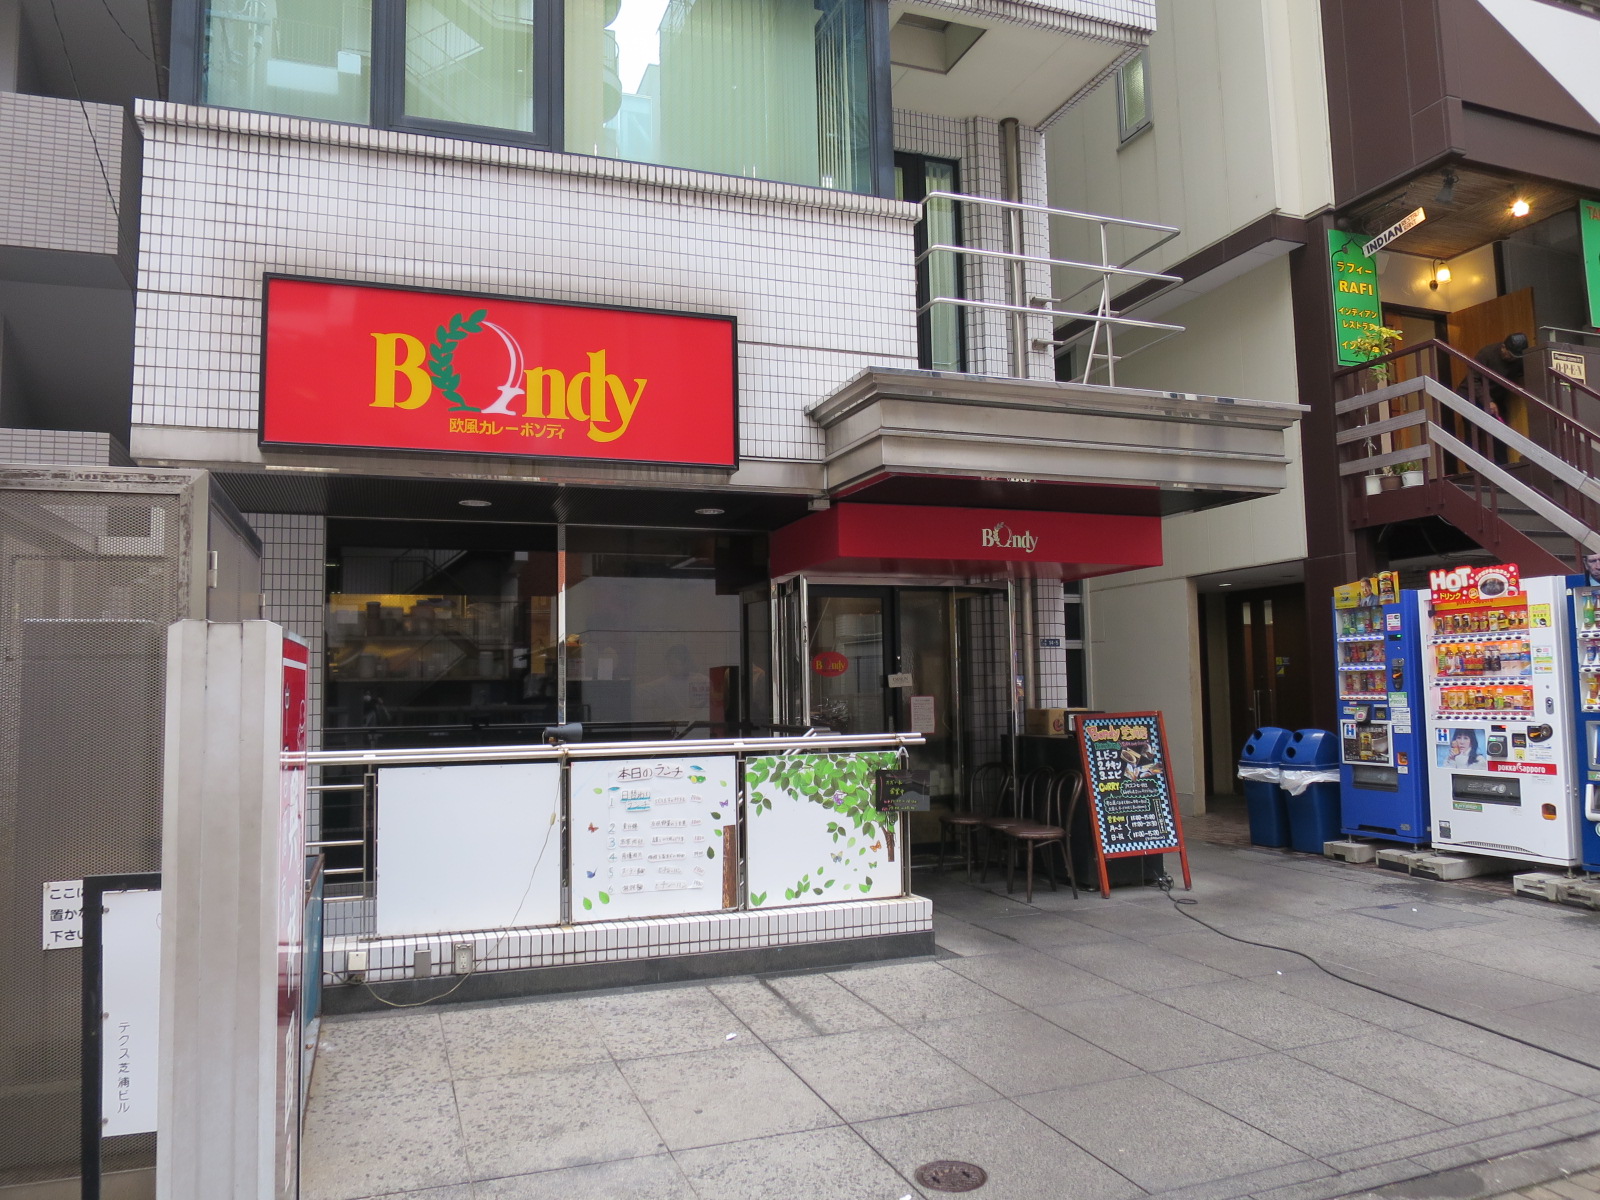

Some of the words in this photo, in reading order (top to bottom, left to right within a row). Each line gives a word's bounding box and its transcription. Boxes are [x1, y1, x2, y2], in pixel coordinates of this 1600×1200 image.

[1366, 223, 1404, 254] INDIAN
[1336, 261, 1373, 275] ラフィー
[1338, 280, 1374, 296] RAFI
[1338, 307, 1378, 319] インディアン
[1429, 567, 1472, 592] HOT
[1439, 592, 1462, 601] ドリンク
[117, 1021, 131, 1114] テクス芝浦ビル
